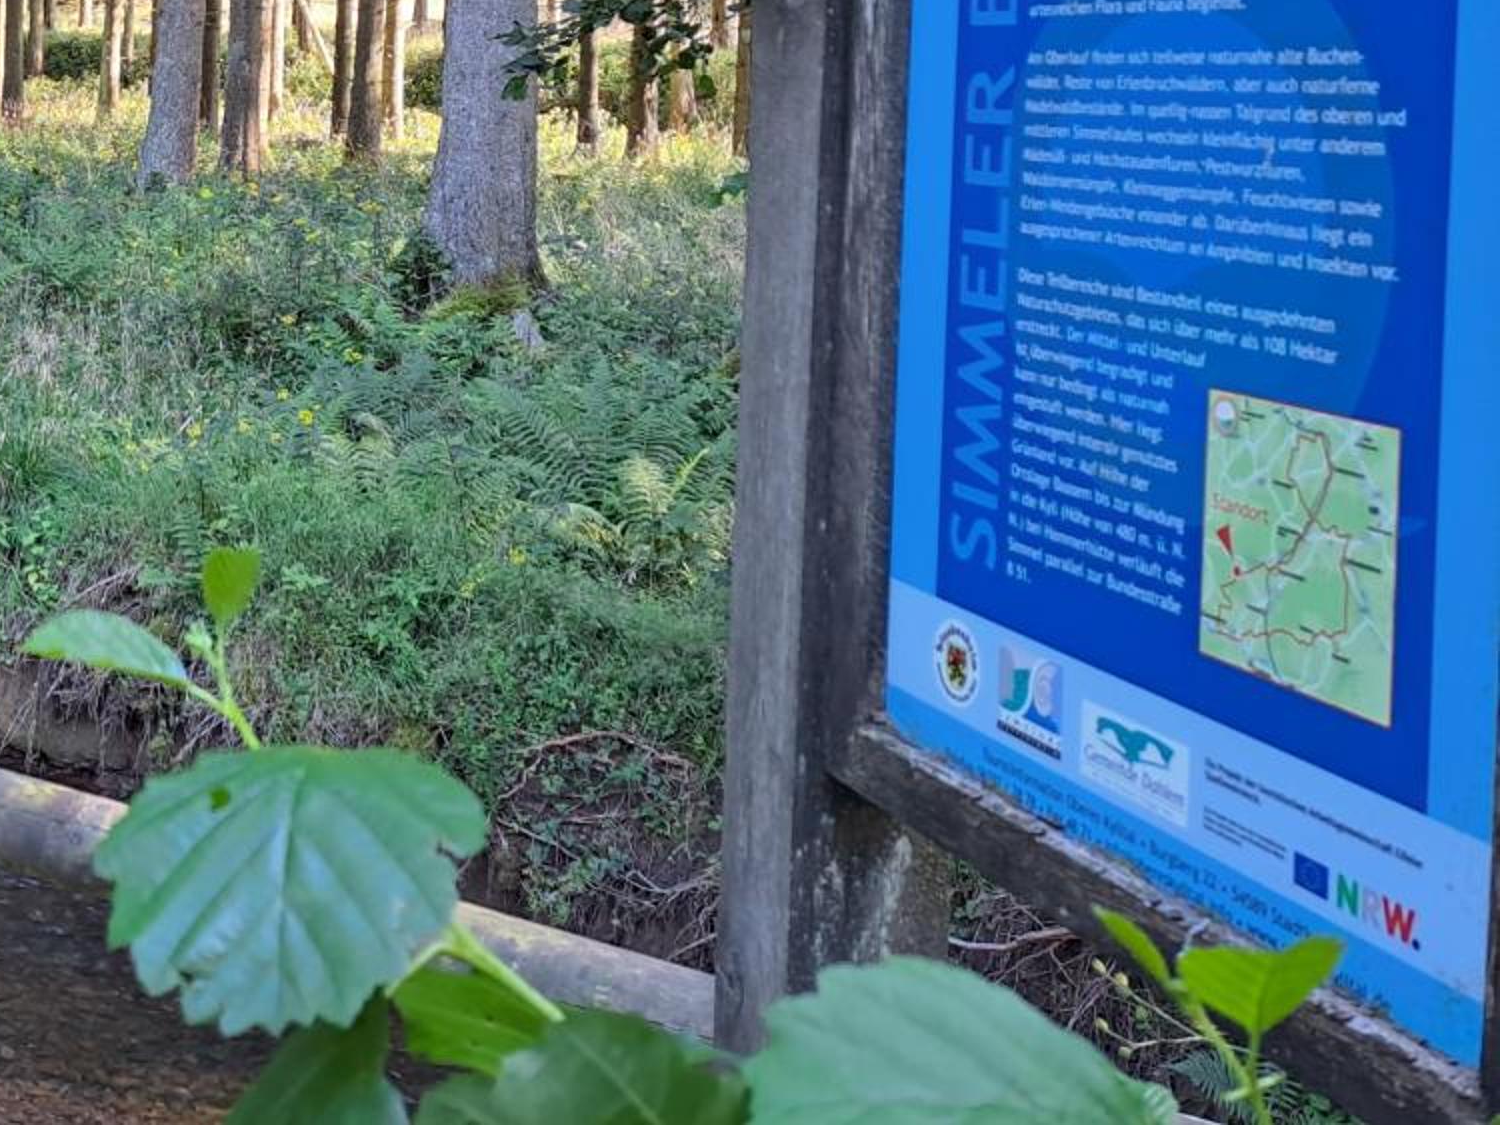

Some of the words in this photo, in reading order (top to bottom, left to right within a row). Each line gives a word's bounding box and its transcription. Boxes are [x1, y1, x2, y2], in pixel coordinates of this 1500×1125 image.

[1276, 47, 1303, 64] alte
[1306, 47, 1364, 65] Buchen-
[1232, 76, 1261, 92] aber
[1265, 76, 1298, 93] auch
[1300, 76, 1380, 95] naturferne
[1235, 104, 1290, 126] Talgrund
[1293, 105, 1318, 123] des
[1320, 106, 1373, 126] oberen
[1376, 108, 1407, 127] und
[1278, 134, 1315, 153] unter
[1318, 136, 1387, 157] anderem
[1338, 197, 1382, 218] sowie
[1311, 225, 1345, 248] liegt
[1347, 228, 1373, 248] ein
[1205, 241, 1273, 269] Amphibien
[1276, 249, 1303, 269] und
[1306, 253, 1368, 278] Insekten
[1371, 263, 1400, 282] vor.
[949, 63, 1016, 572] SIMMELER
[1204, 297, 1238, 318] eines
[1241, 303, 1335, 338] ausgedehnten
[1148, 315, 1171, 334] sich
[1173, 319, 1201, 340] über
[1203, 325, 1236, 347] mehr
[1240, 332, 1259, 351] als
[1262, 336, 1286, 356] 108
[1289, 340, 1337, 366] Hektar
[1125, 337, 1148, 356] und
[1150, 342, 1206, 368] Unterlauf
[1151, 370, 1173, 389] und
[1129, 472, 1149, 493] der
[1094, 488, 1110, 508] bis
[1112, 496, 1130, 515] zur
[1211, 490, 1269, 526] Standort
